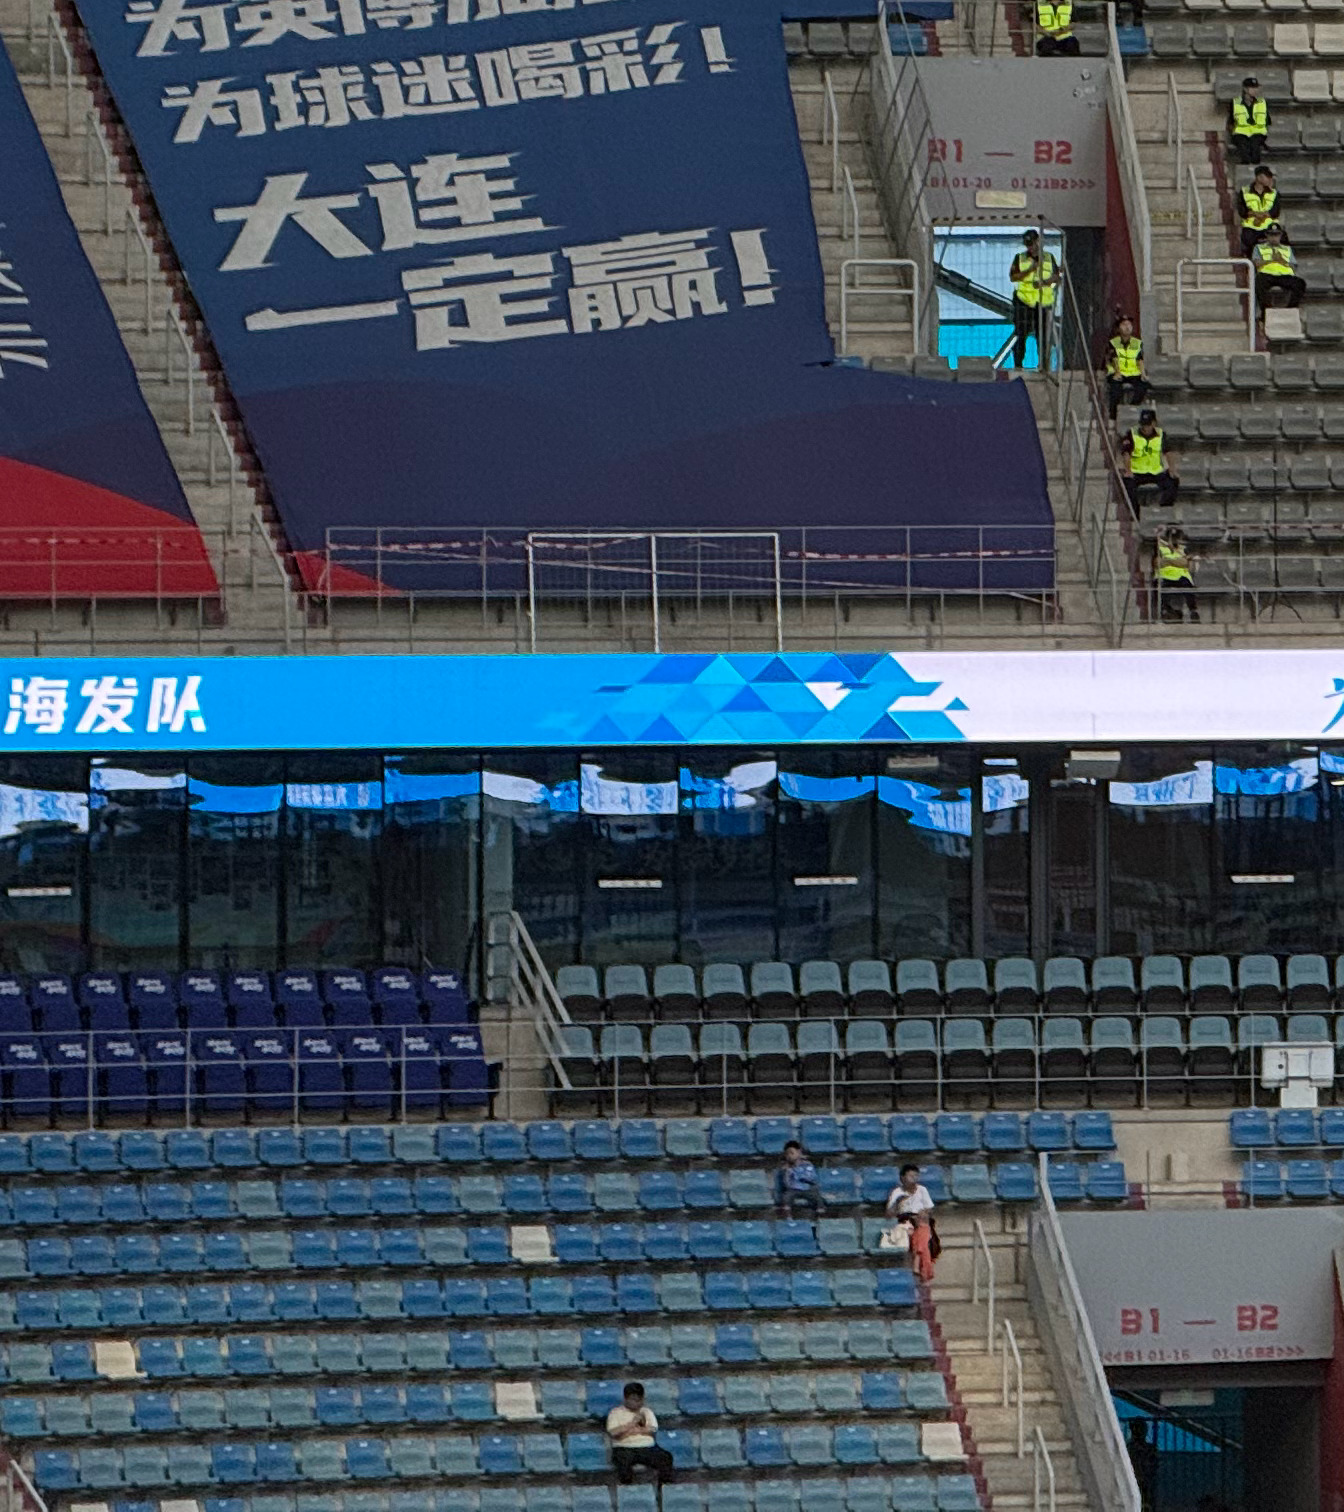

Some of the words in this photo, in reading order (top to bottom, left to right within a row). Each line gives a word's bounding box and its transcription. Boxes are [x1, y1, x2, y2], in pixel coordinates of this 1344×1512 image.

[928, 139, 963, 163] B1
[1034, 140, 1072, 164] B2
[213, 151, 565, 270] 大连
[3, 676, 208, 734] 海发队
[1121, 1308, 1160, 1335] B1
[1237, 1304, 1279, 1331] B2
